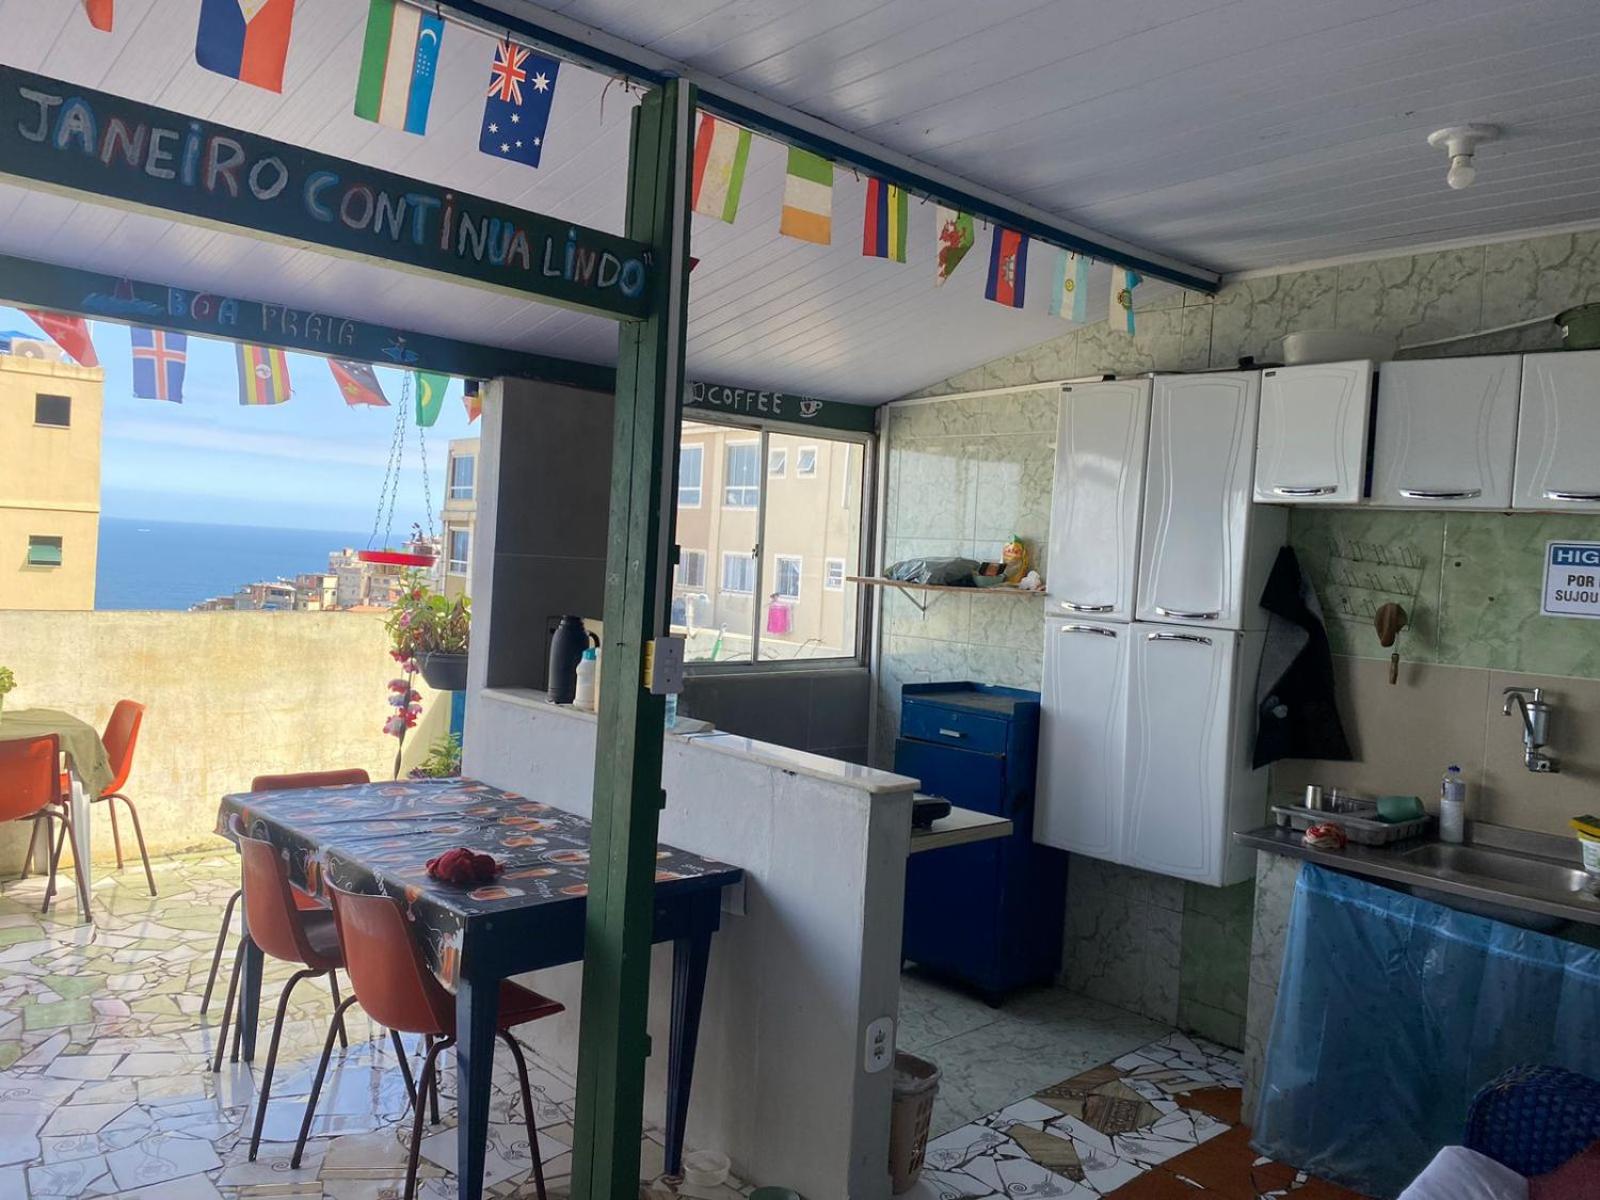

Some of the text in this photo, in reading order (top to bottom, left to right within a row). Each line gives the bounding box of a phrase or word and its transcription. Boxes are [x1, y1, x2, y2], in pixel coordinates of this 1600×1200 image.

[707, 386, 783, 414] COFFEE
[1567, 574, 1595, 588] POR
[1555, 589, 1599, 603] SUJOU
